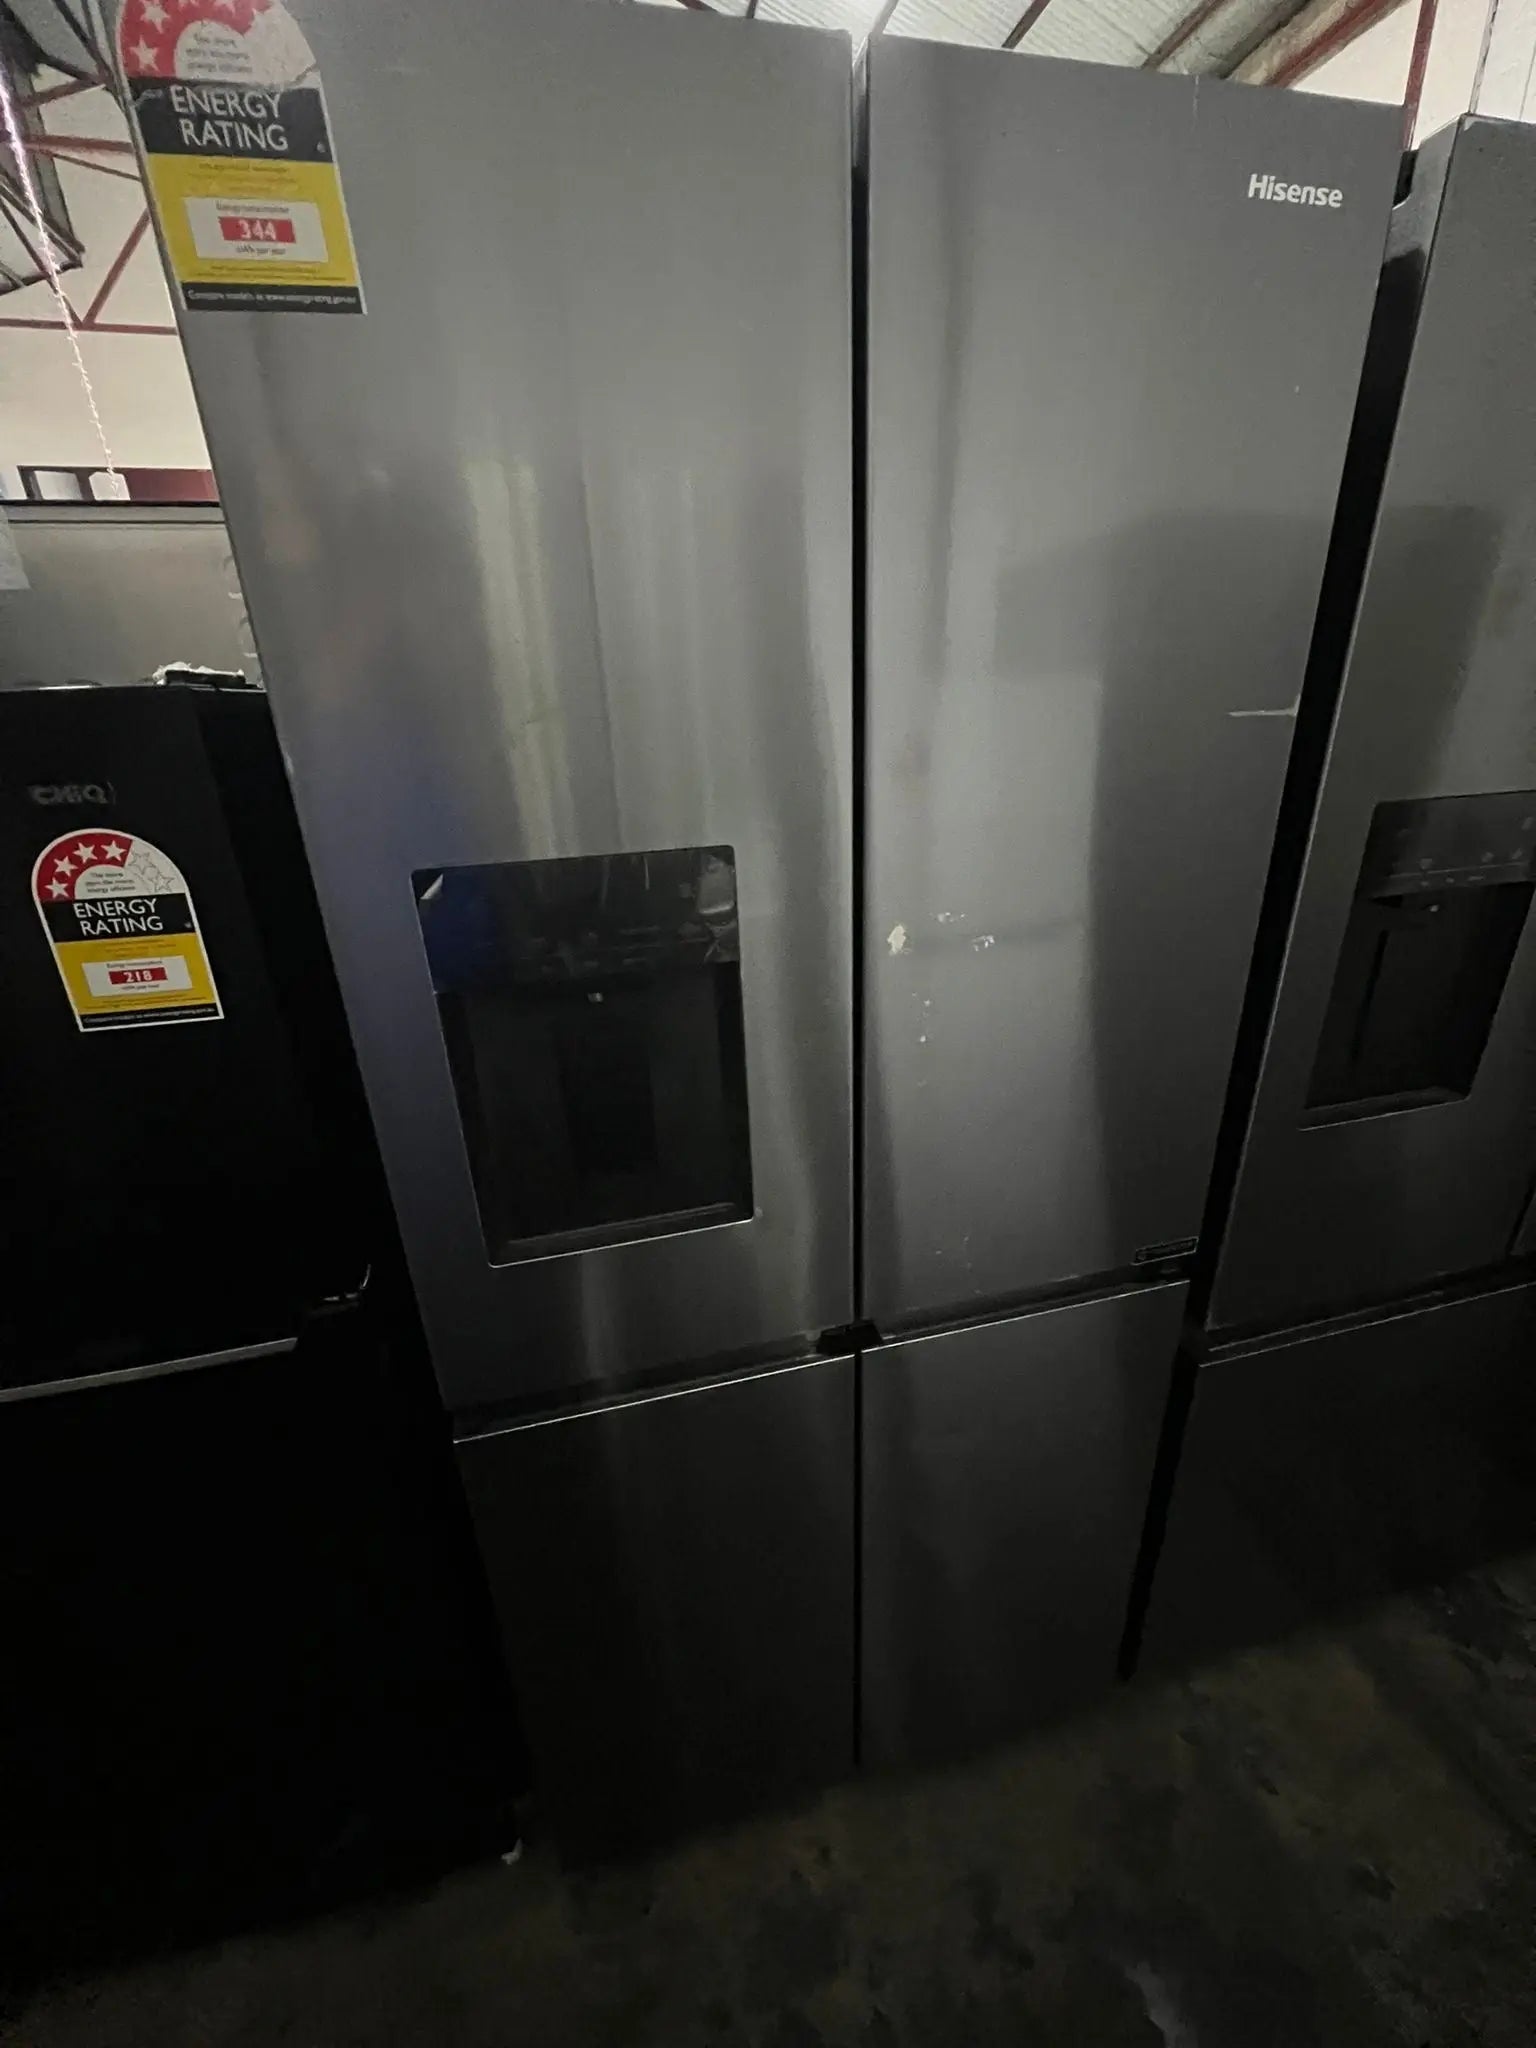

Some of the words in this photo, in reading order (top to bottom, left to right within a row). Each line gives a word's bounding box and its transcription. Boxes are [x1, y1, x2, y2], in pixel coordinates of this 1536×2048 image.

[170, 85, 282, 119] ENERGY
[180, 119, 289, 152] RATING
[1247, 172, 1344, 208] Hisense
[237, 219, 277, 241] 344
[73, 898, 157, 919] ENERGY
[80, 915, 164, 937] RATING
[122, 970, 153, 983] 218
